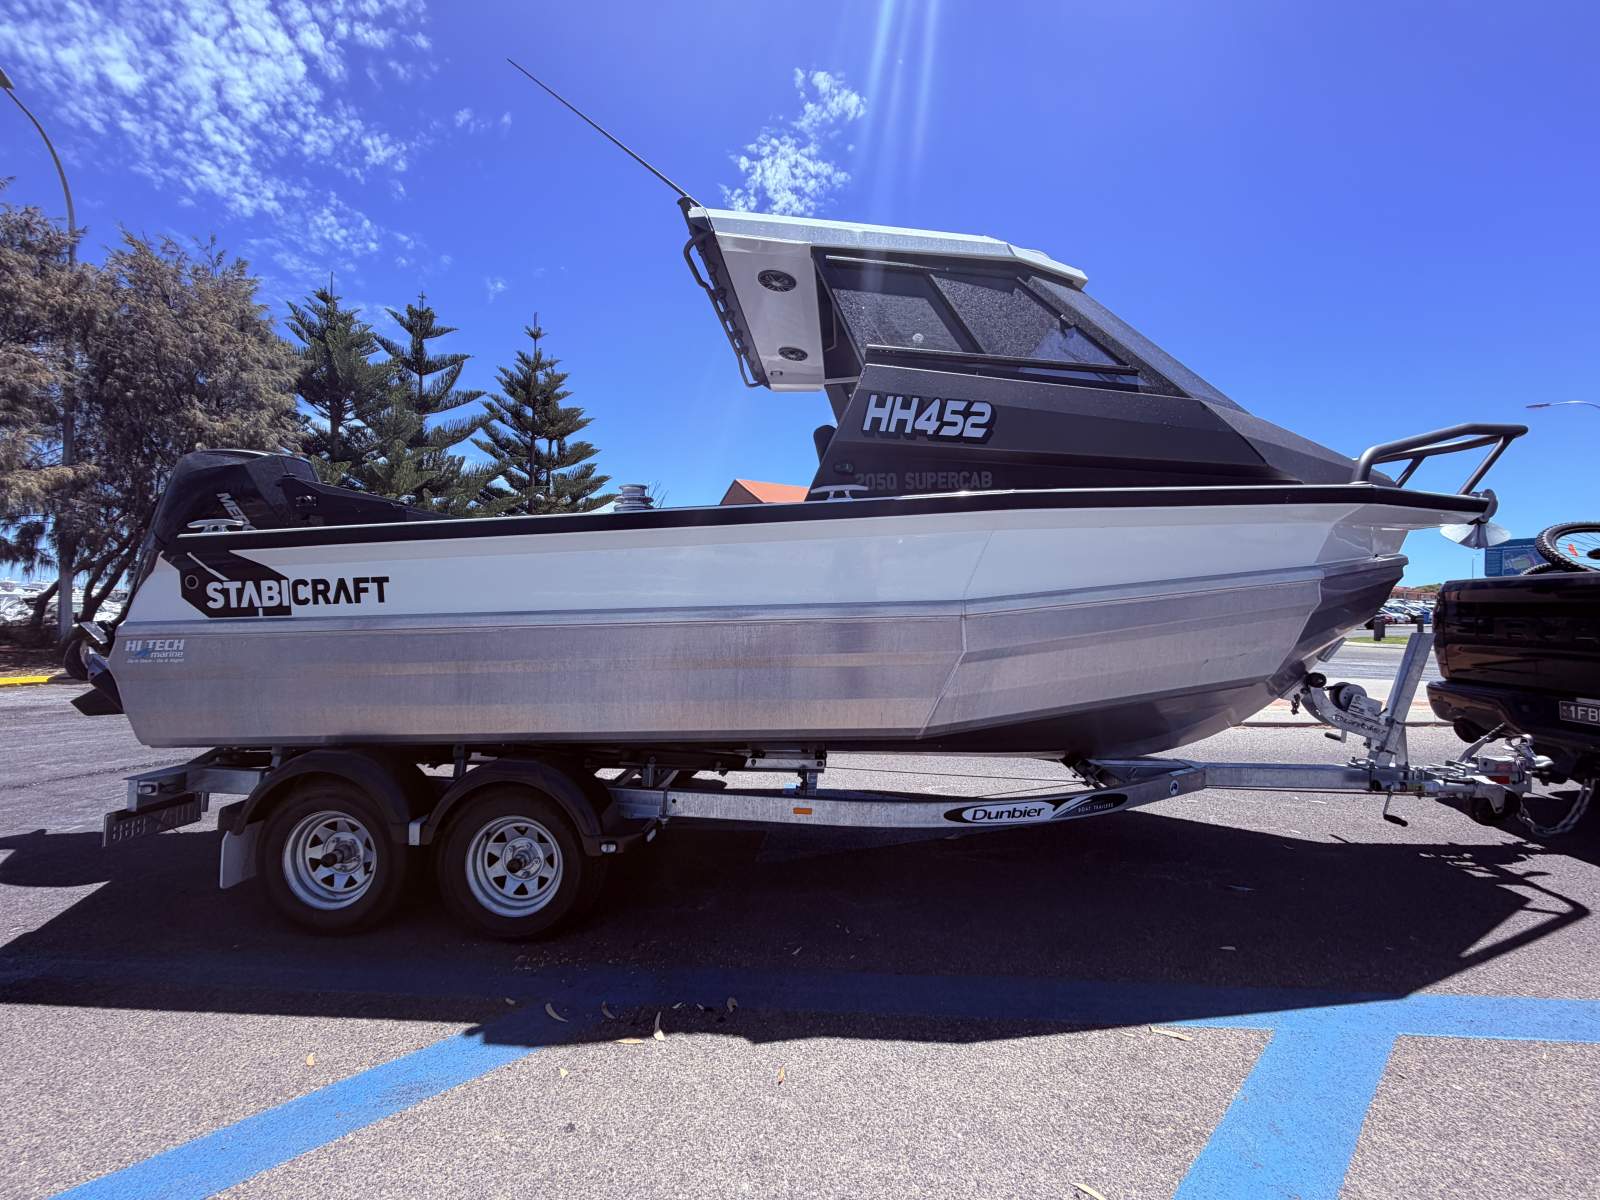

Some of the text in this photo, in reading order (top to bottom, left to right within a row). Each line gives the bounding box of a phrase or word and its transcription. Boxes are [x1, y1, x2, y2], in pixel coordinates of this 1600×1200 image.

[862, 393, 993, 439] HH452
[905, 471, 993, 490] SUPERCAB
[206, 576, 389, 609] STABICRAFT
[1570, 705, 1600, 722] 1FB
[972, 807, 1045, 820] Dunbier
